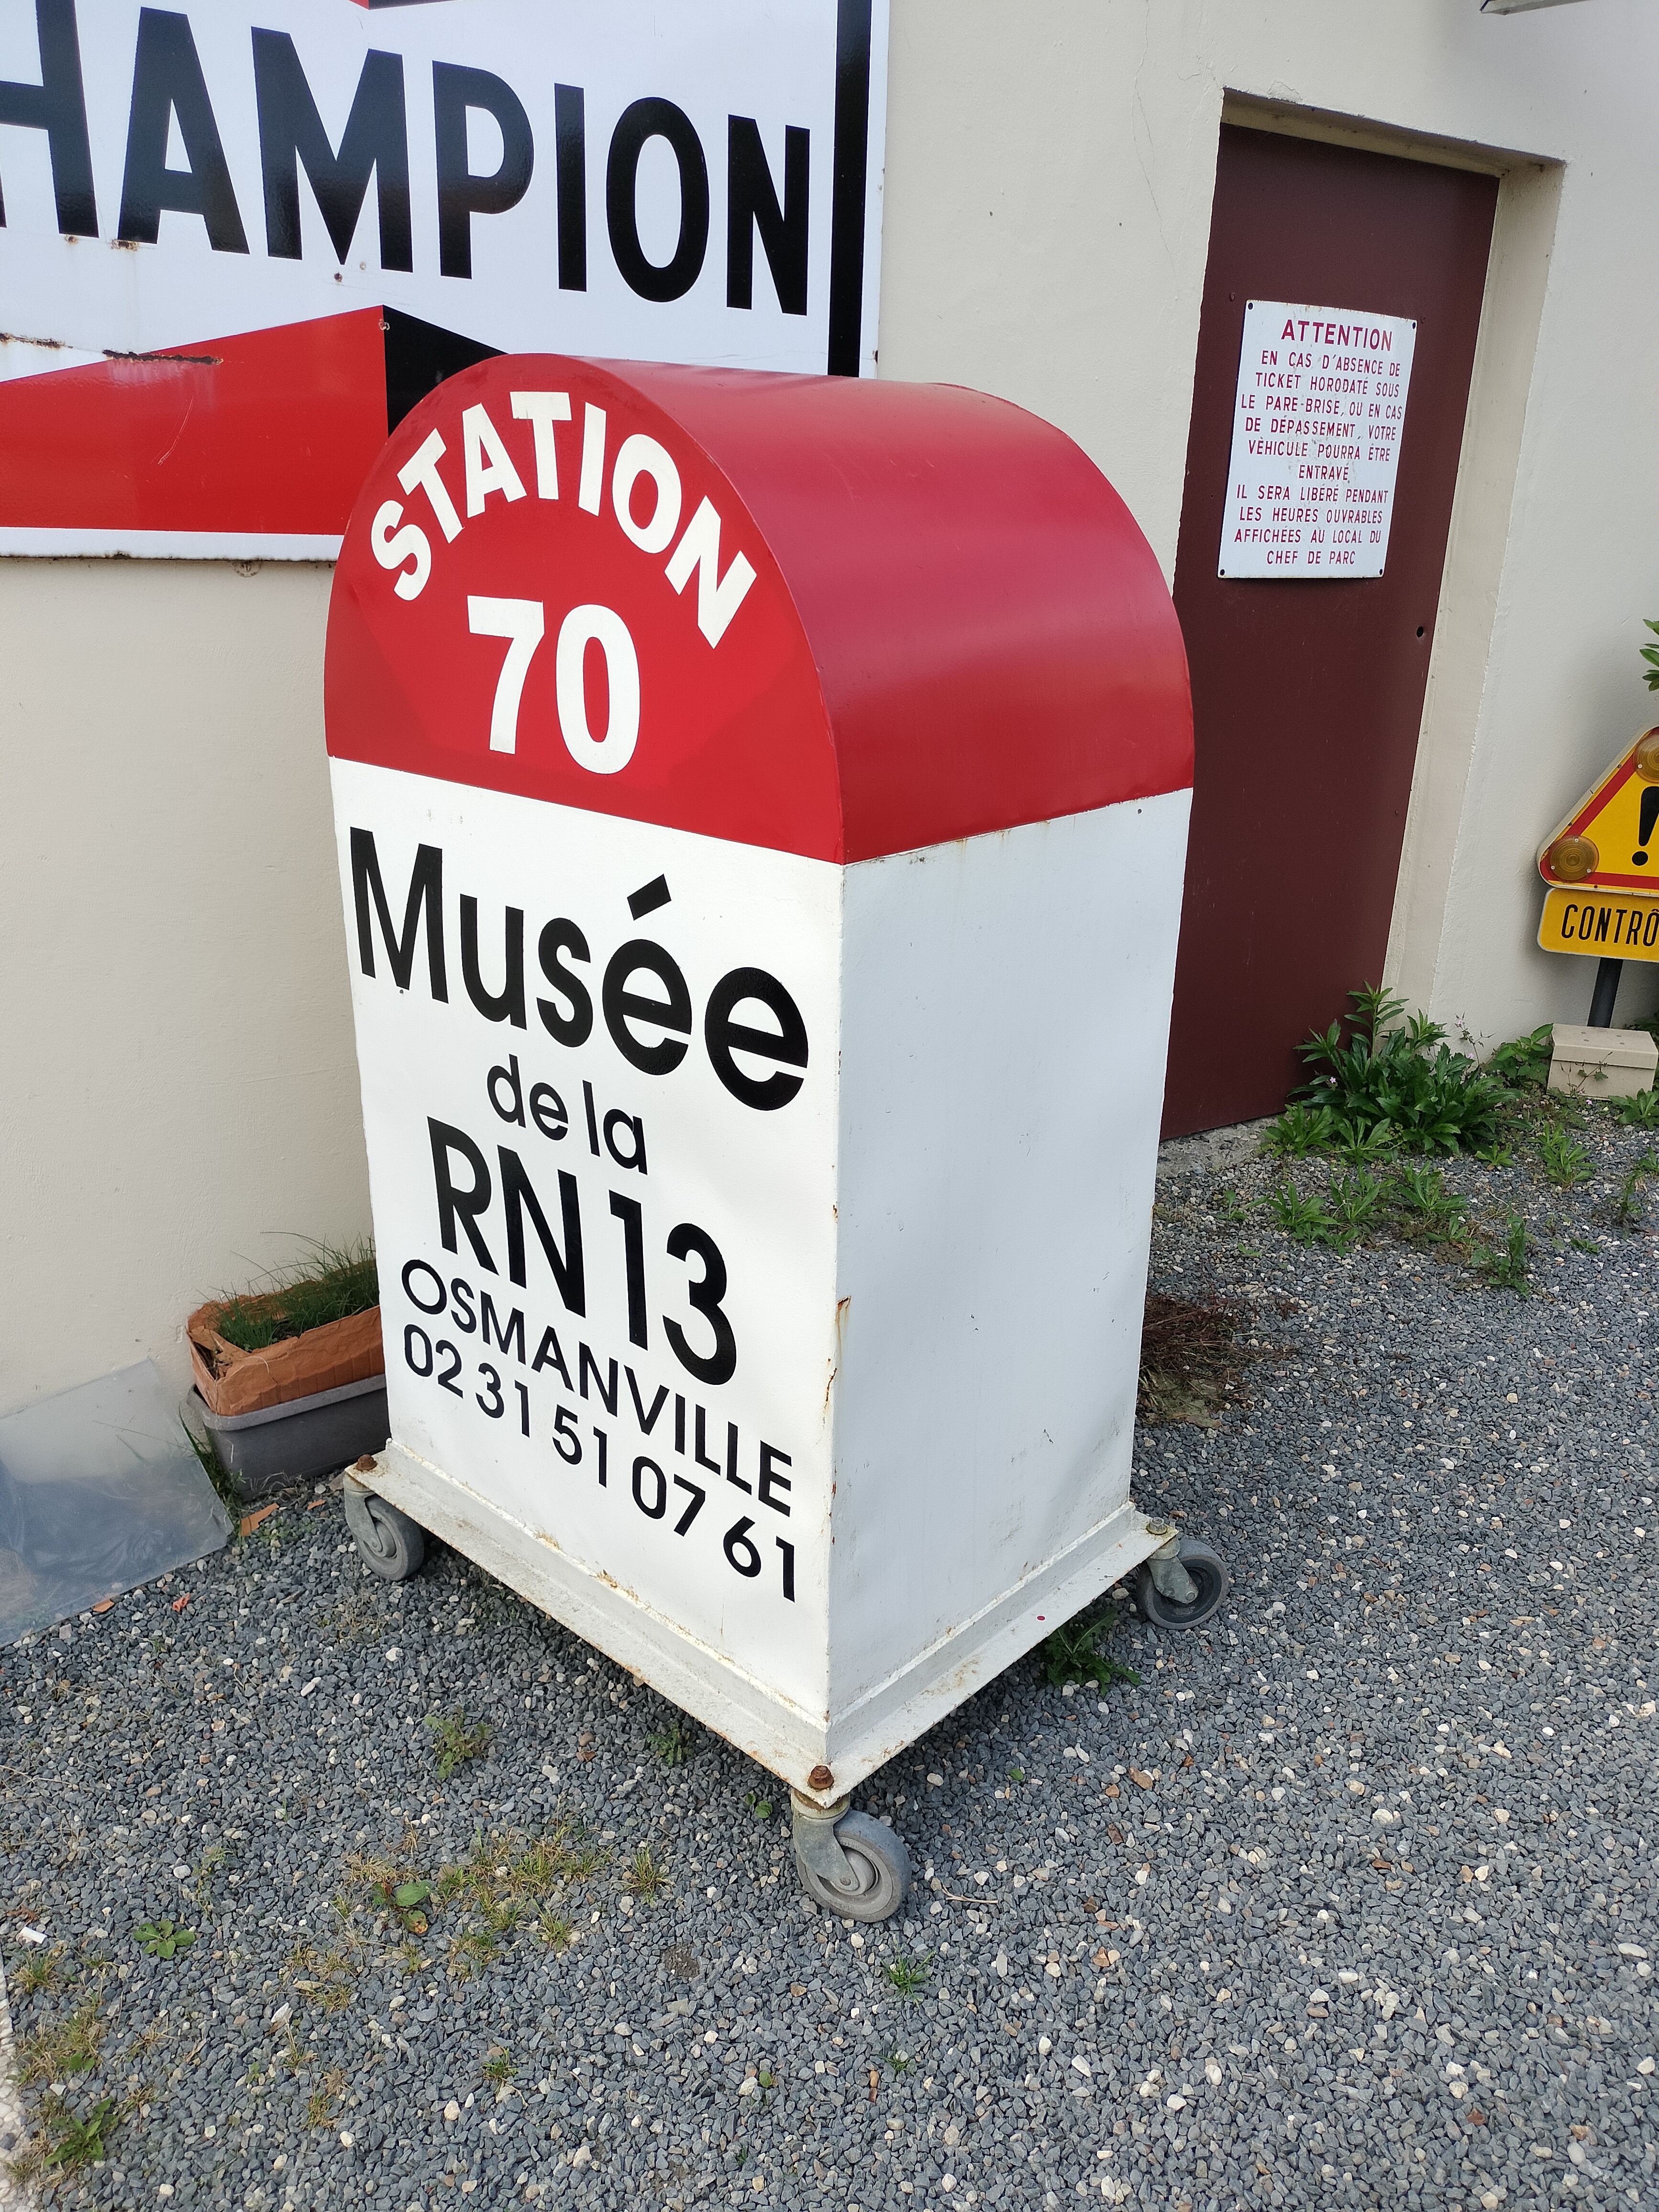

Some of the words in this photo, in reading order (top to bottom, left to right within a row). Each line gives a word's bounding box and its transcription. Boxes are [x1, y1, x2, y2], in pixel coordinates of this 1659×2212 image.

[1281, 320, 1392, 351] ATTENTION
[1261, 350, 1278, 365] EN
[1289, 352, 1312, 368] CAS
[1322, 354, 1383, 375] D'ABSENCE
[1389, 363, 1401, 376] DE
[1256, 372, 1301, 388] TICKET
[1310, 376, 1368, 395] HORODATÉ
[1376, 382, 1400, 398] SOUS
[1241, 394, 1255, 409] LE
[1266, 396, 1345, 417] PARE-BRISE,
[1349, 401, 1363, 416] OU
[1368, 403, 1380, 418] EN
[1386, 405, 1403, 420] CAS
[1245, 417, 1261, 432] DE
[1369, 425, 1396, 441] VOTRE
[1317, 444, 1360, 460] POURRA
[1368, 443, 1391, 462] ÊTRE
[1299, 463, 1349, 481] ENTRAVÉ
[1237, 484, 1247, 499] IL
[1258, 485, 1290, 500] SERA
[1300, 484, 1339, 502] LIBÉRÉ
[1346, 489, 1389, 503] PENDANT
[371, 391, 757, 649] STATION
[1239, 507, 1262, 521] LES
[1272, 508, 1318, 523] HEURES
[1327, 509, 1382, 524] OUVRABLES
[1234, 526, 1301, 543] AFFICHÉES
[1310, 530, 1325, 543] AU
[1333, 530, 1362, 543] LOCAL
[1370, 530, 1382, 543] DU
[1267, 551, 1298, 564] CHEF
[1307, 551, 1321, 564] DE
[1329, 551, 1356, 564] PARC
[467, 595, 641, 775] 70
[1561, 904, 1659, 947] CONTRÔ
[350, 826, 809, 1112] Musée
[487, 1054, 569, 1141] de
[582, 1079, 648, 1175] la
[401, 1259, 792, 1517] OSMANVILLE
